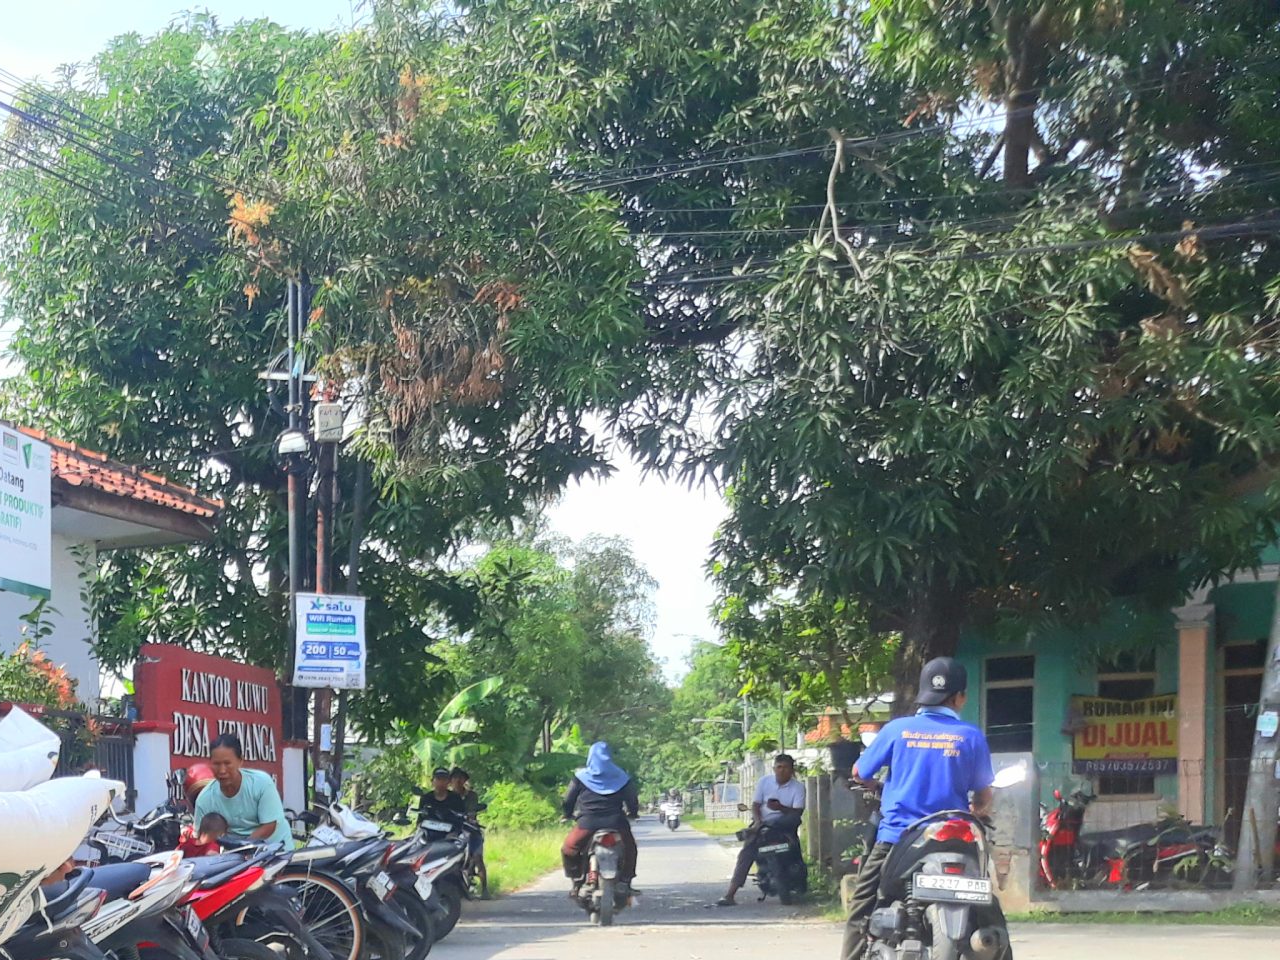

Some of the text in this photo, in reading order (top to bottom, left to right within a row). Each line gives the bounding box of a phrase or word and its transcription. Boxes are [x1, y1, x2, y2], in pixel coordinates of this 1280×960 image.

[3, 491, 44, 519] PRODUKTIF
[305, 644, 327, 655] 200
[333, 646, 346, 656] 50
[181, 668, 268, 714] KANTOR KUWU
[1083, 699, 1145, 716] RUMAH
[173, 711, 211, 758] DESA
[1082, 721, 1174, 747] DIJUAL
